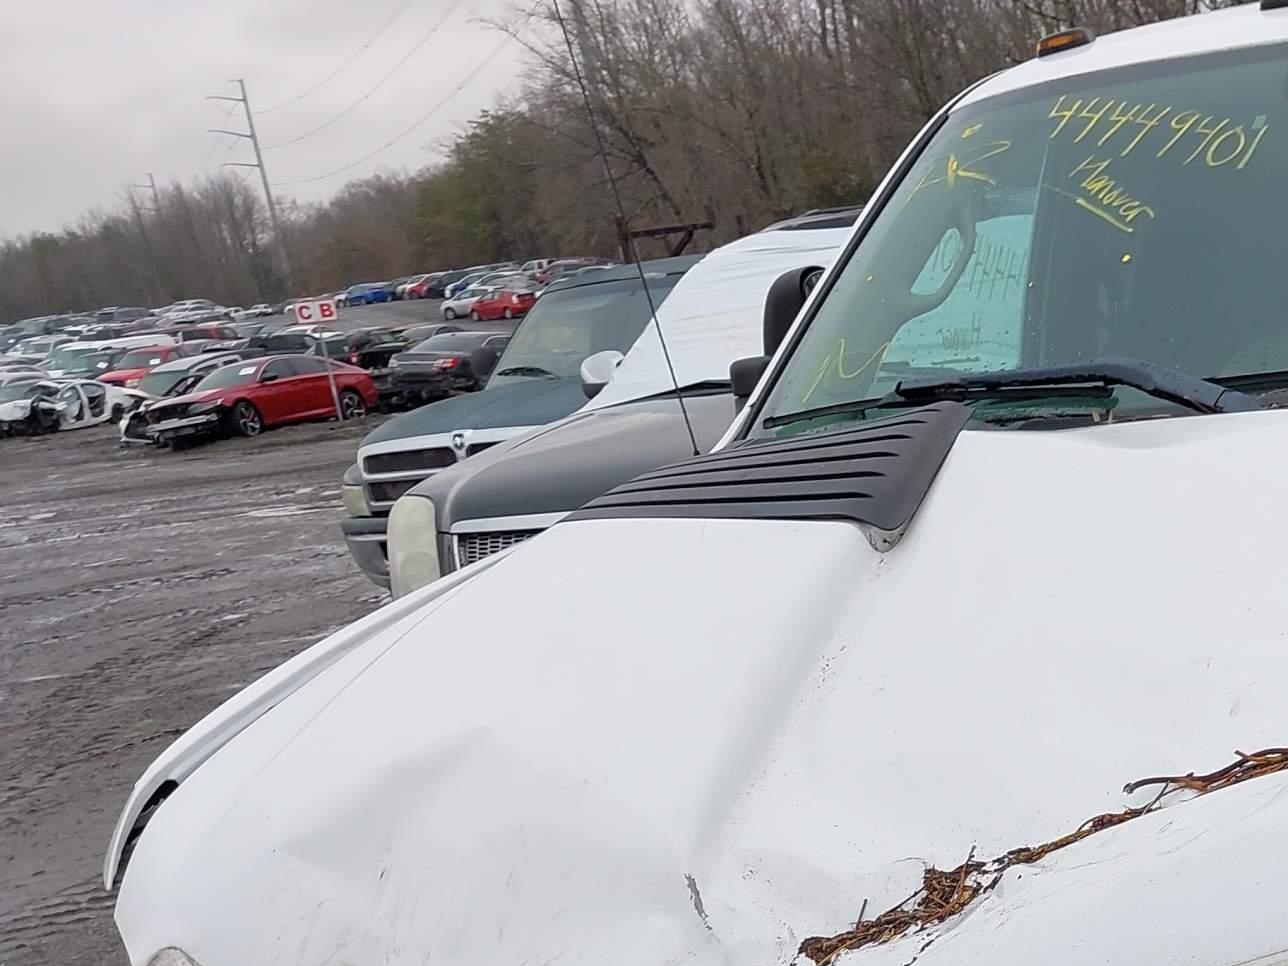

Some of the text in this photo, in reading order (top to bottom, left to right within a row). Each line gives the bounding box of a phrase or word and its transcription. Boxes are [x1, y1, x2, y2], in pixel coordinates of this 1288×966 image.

[1048, 95, 1268, 170] 44449401
[298, 303, 334, 320] C B
